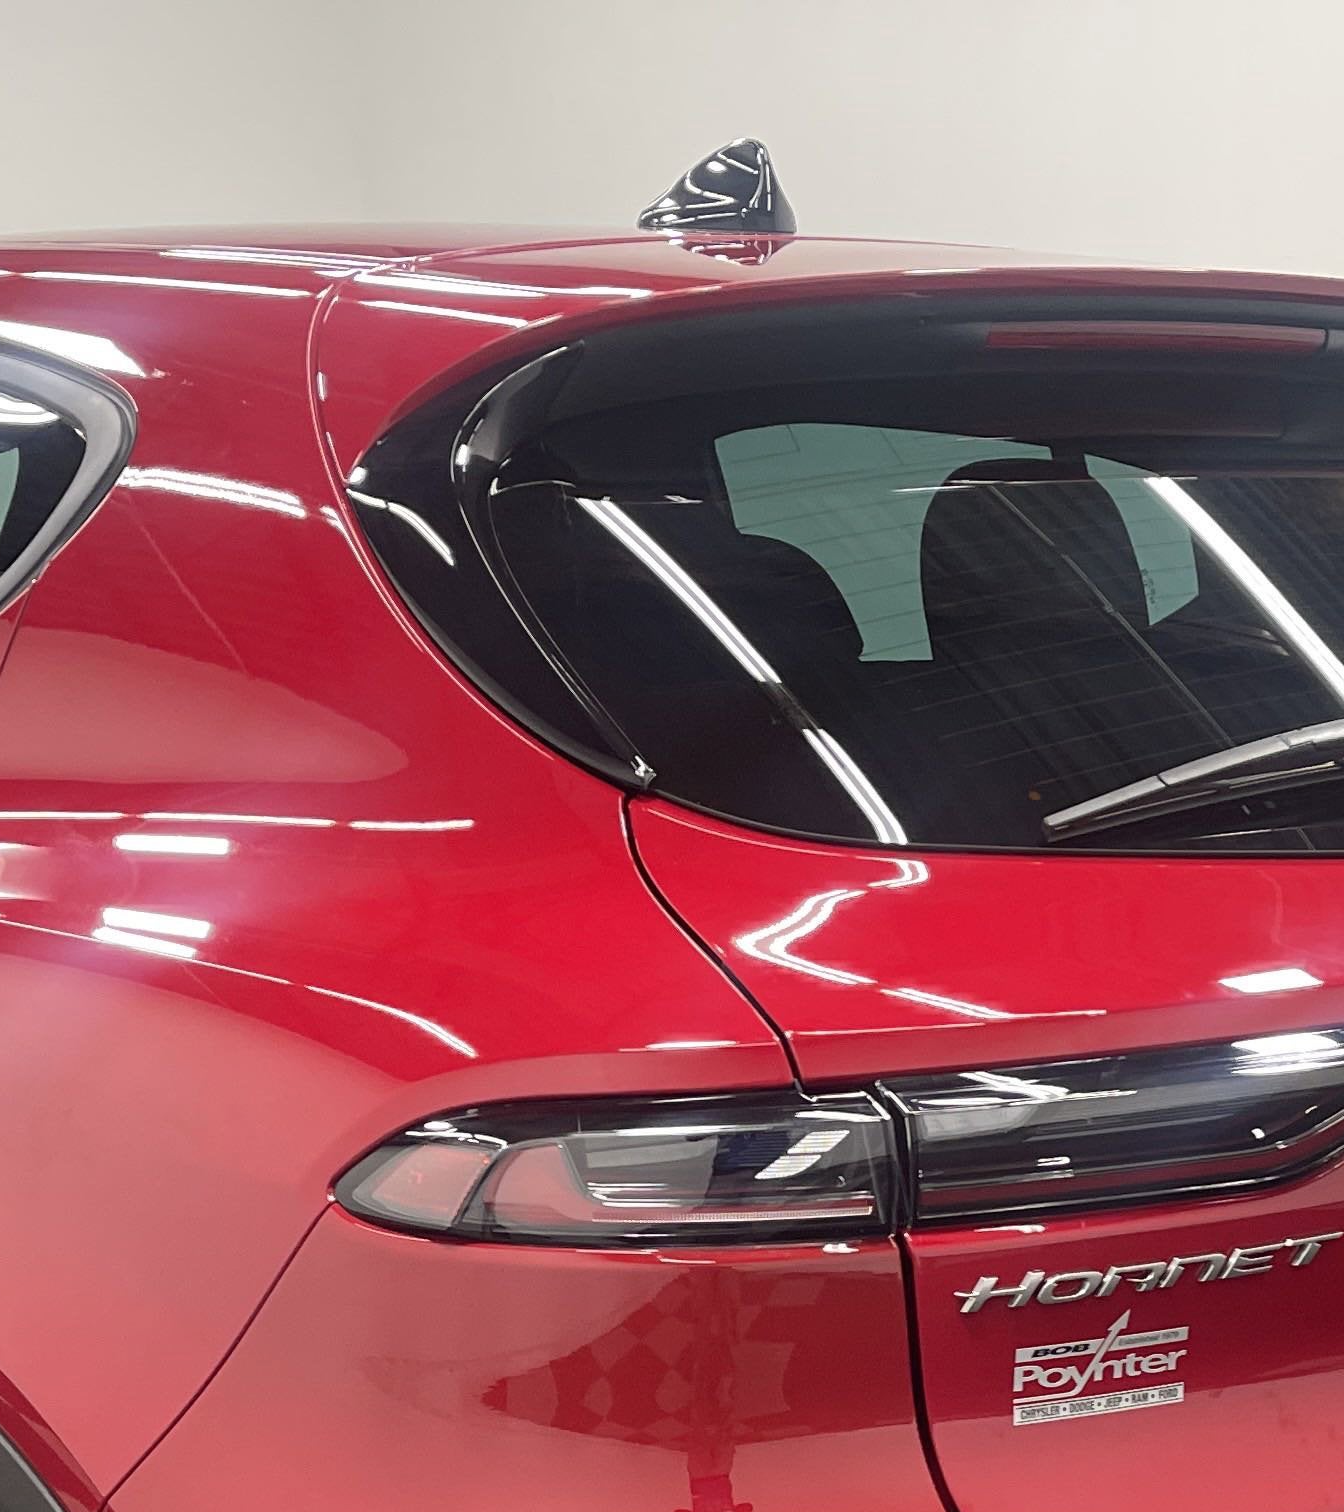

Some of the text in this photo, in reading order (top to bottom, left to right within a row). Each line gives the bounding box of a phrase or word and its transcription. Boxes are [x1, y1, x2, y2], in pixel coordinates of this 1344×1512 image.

[953, 1231, 1344, 1313] HORNET
[1032, 1344, 1090, 1358] BOB
[1012, 1349, 1188, 1395] Poynter
[1020, 1387, 1179, 1420] CHRYSLER DODGE JEEP RAM FORD
